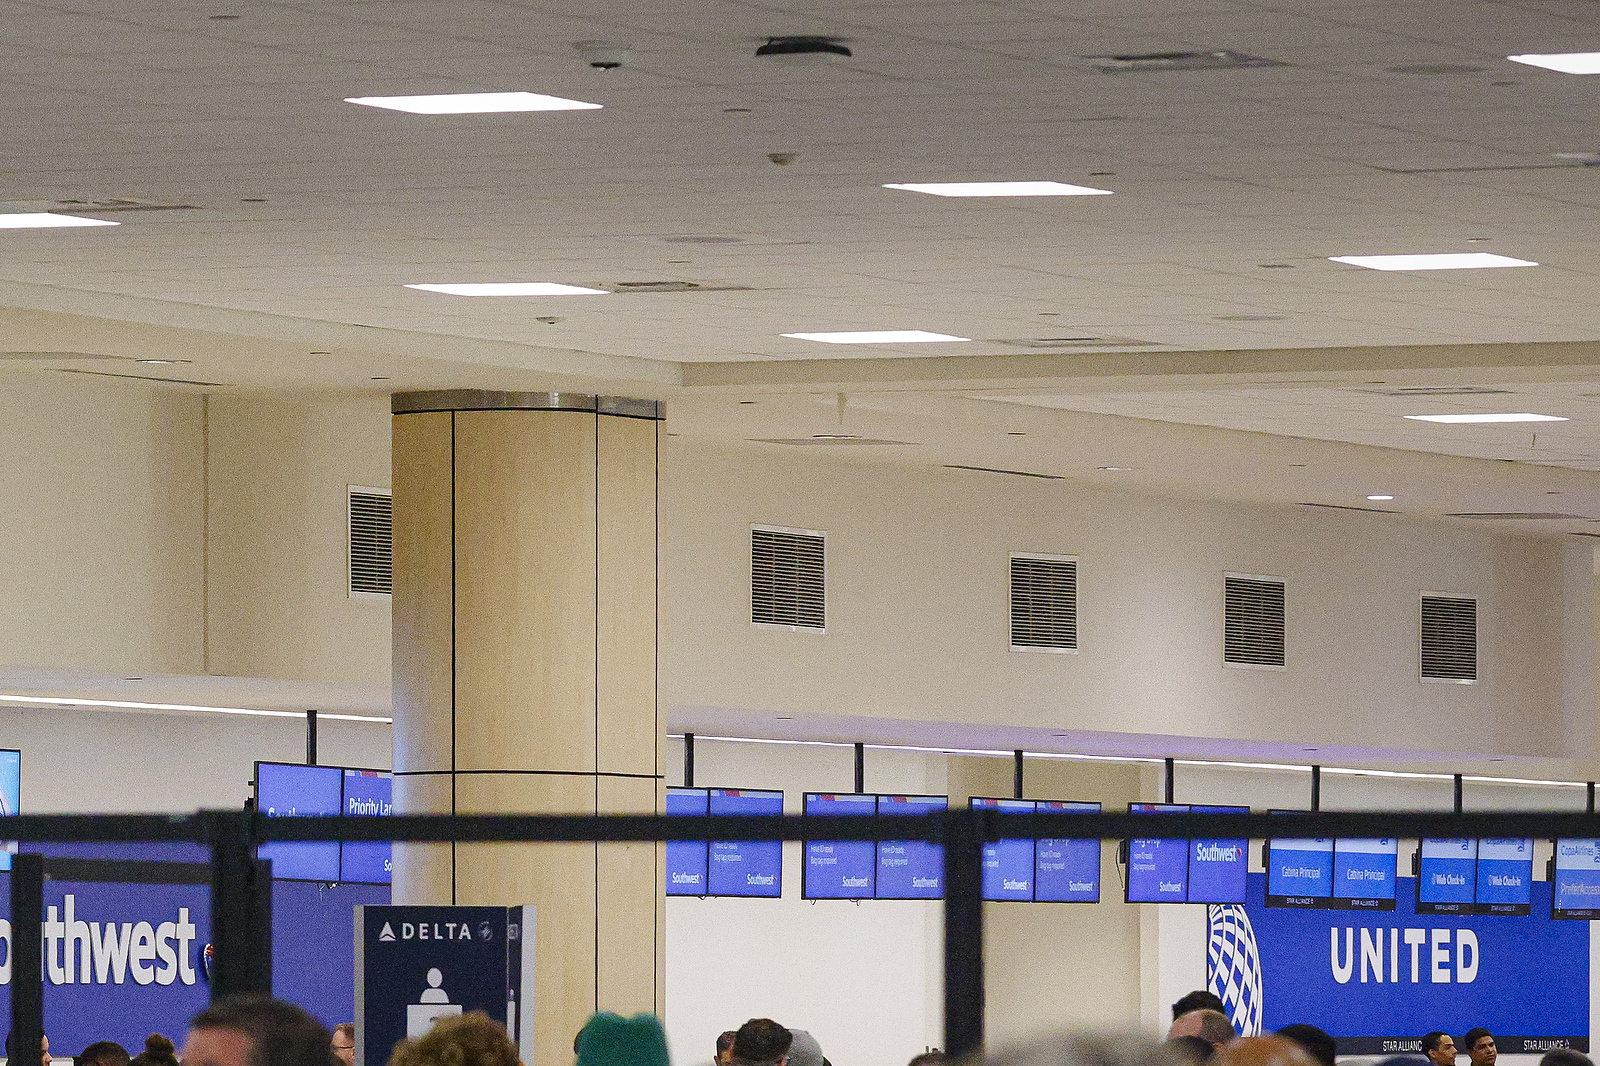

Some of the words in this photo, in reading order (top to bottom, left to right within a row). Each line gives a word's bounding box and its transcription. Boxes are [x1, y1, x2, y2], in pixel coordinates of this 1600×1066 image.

[349, 798, 379, 816] Priority
[1196, 842, 1237, 862] Southwest
[672, 872, 700, 884] Southwest
[747, 873, 774, 886] Southwest
[842, 876, 868, 887] Southwest
[912, 876, 938, 888] Southwest
[1003, 879, 1028, 890] Southwest
[1069, 880, 1093, 891] Southwest
[1159, 881, 1181, 892] Southwest
[402, 922, 472, 940] DELTA
[1330, 926, 1480, 984] UNITED
[1382, 1040, 1398, 1052] STAR
[1398, 1040, 1422, 1052] ALLIANC
[1523, 1040, 1537, 1050] STAR
